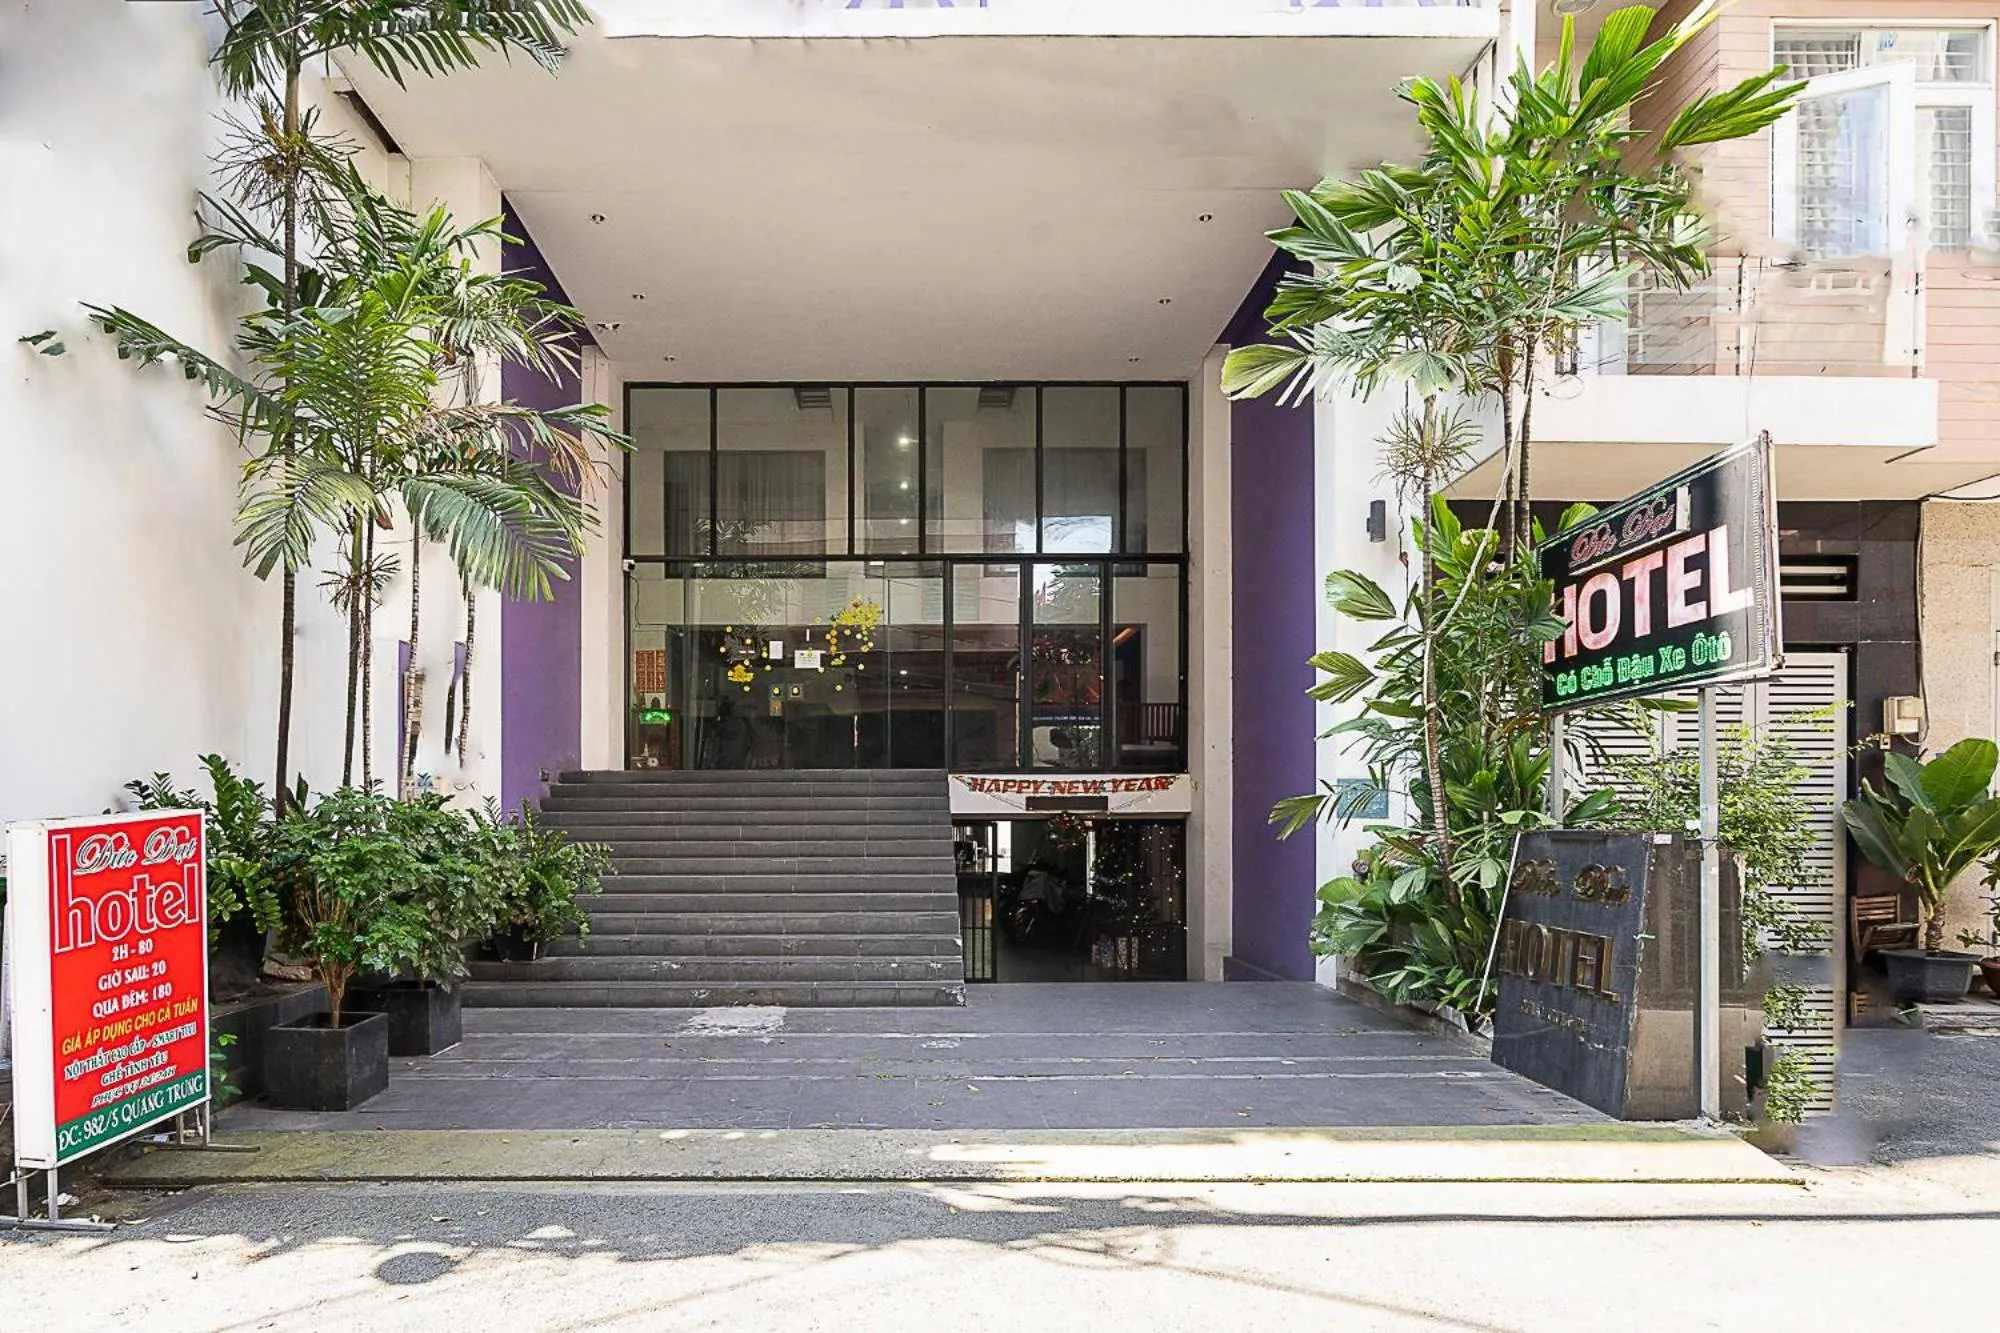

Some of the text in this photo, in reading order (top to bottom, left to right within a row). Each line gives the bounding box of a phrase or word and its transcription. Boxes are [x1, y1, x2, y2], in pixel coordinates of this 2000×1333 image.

[1544, 524, 1754, 664] HOTEL
[1556, 631, 1732, 697] Có Chỗ Đậu Xe Ôtô
[969, 775, 1174, 795] HAPPY NEW YEAR
[73, 826, 197, 875] Đức Đạt
[52, 834, 199, 954] hotel
[112, 943, 129, 961] 2H
[138, 939, 153, 955] 80
[98, 960, 166, 991] GIỜ SAU: 20
[84, 1026, 101, 1047] ÁP
[102, 1020, 132, 1043] DỤNG
[134, 1012, 156, 1031] CHO
[157, 1001, 171, 1023] CẢ
[92, 983, 172, 1019] QUA ĐÊM: 180
[64, 1060, 84, 1080] NỘI
[151, 1027, 180, 1048] SMART
[101, 1062, 124, 1086] GHẾ
[58, 1075, 203, 1152] ĐC: 982/5 QUANG TRUNG
